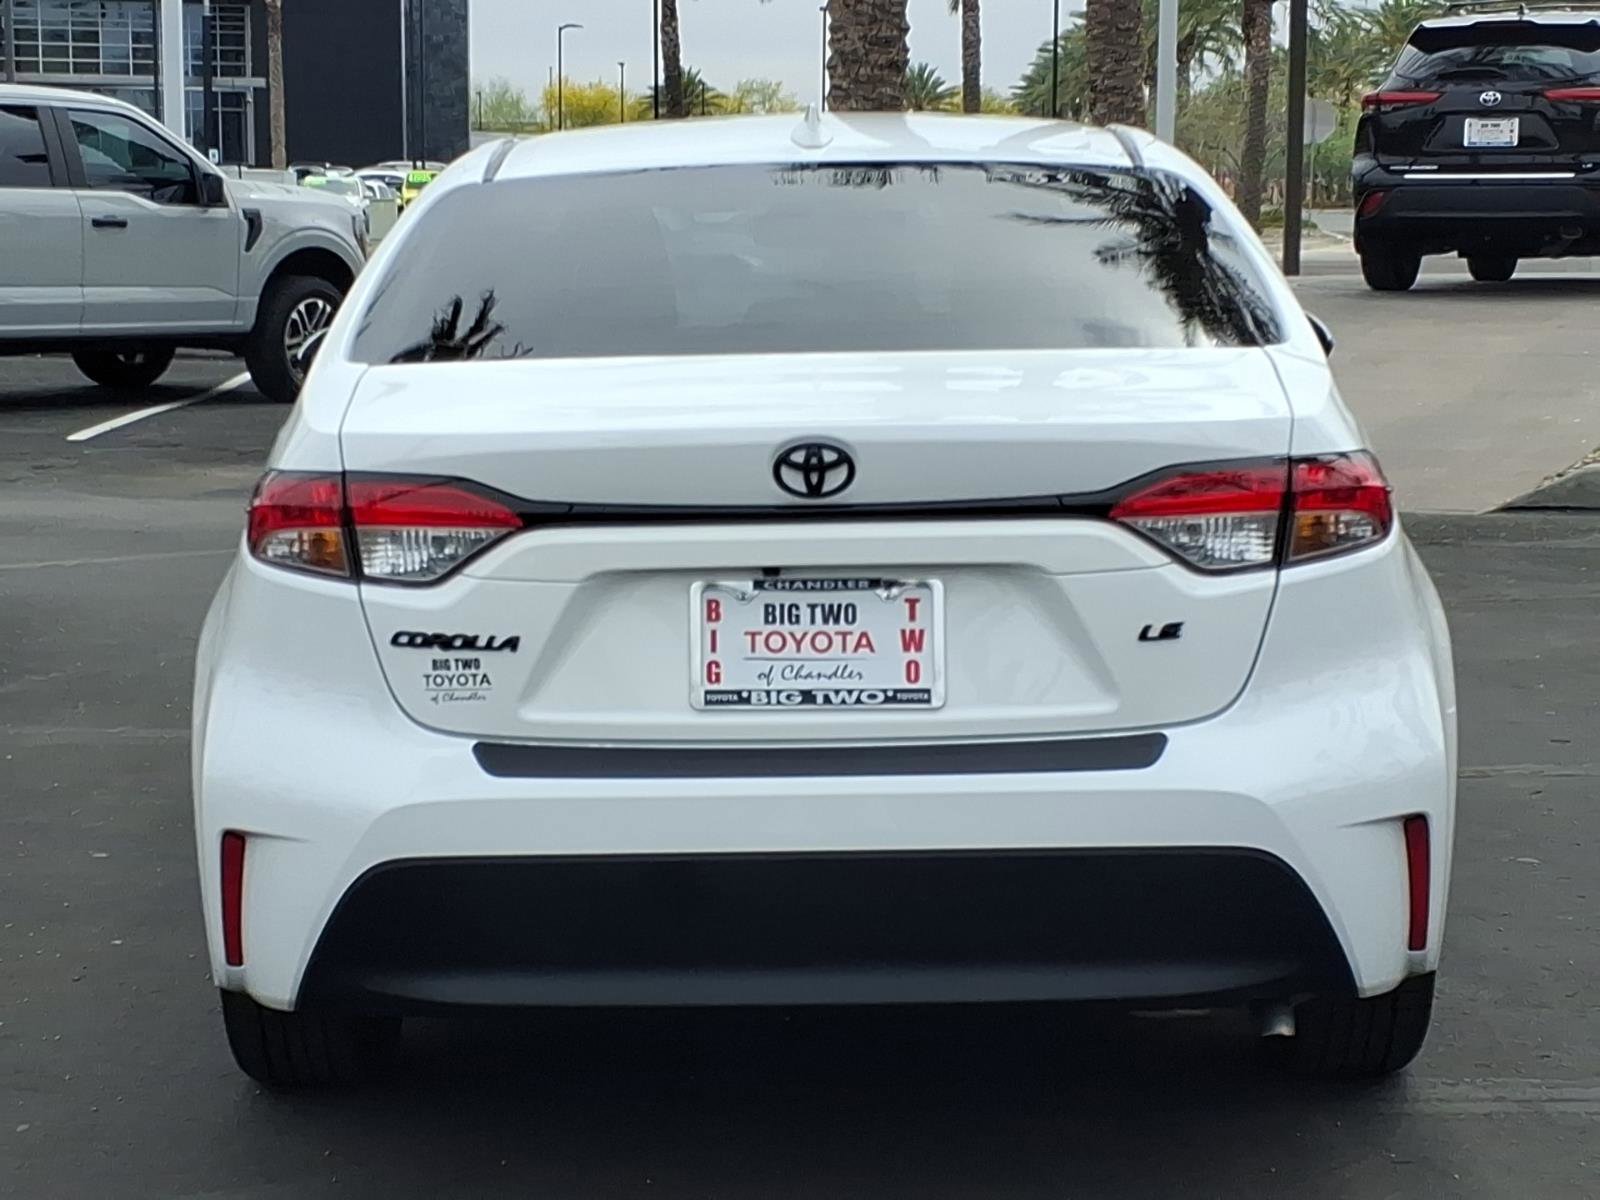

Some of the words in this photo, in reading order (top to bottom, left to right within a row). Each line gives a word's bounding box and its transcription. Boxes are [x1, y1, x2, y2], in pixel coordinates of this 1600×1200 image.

[763, 581, 869, 591] CHANDLER
[764, 603, 800, 625] BIG
[807, 603, 857, 625] TWO
[390, 630, 520, 653] COROLLA
[744, 631, 875, 653] TOYOTA
[1138, 621, 1184, 642] LE
[432, 658, 450, 671] BIG
[454, 657, 481, 671] TWO
[423, 673, 492, 687] TOYOTA
[757, 664, 774, 687] of
[781, 664, 863, 681] Chandler
[750, 690, 803, 705] BIG
[812, 689, 885, 705] TWO
